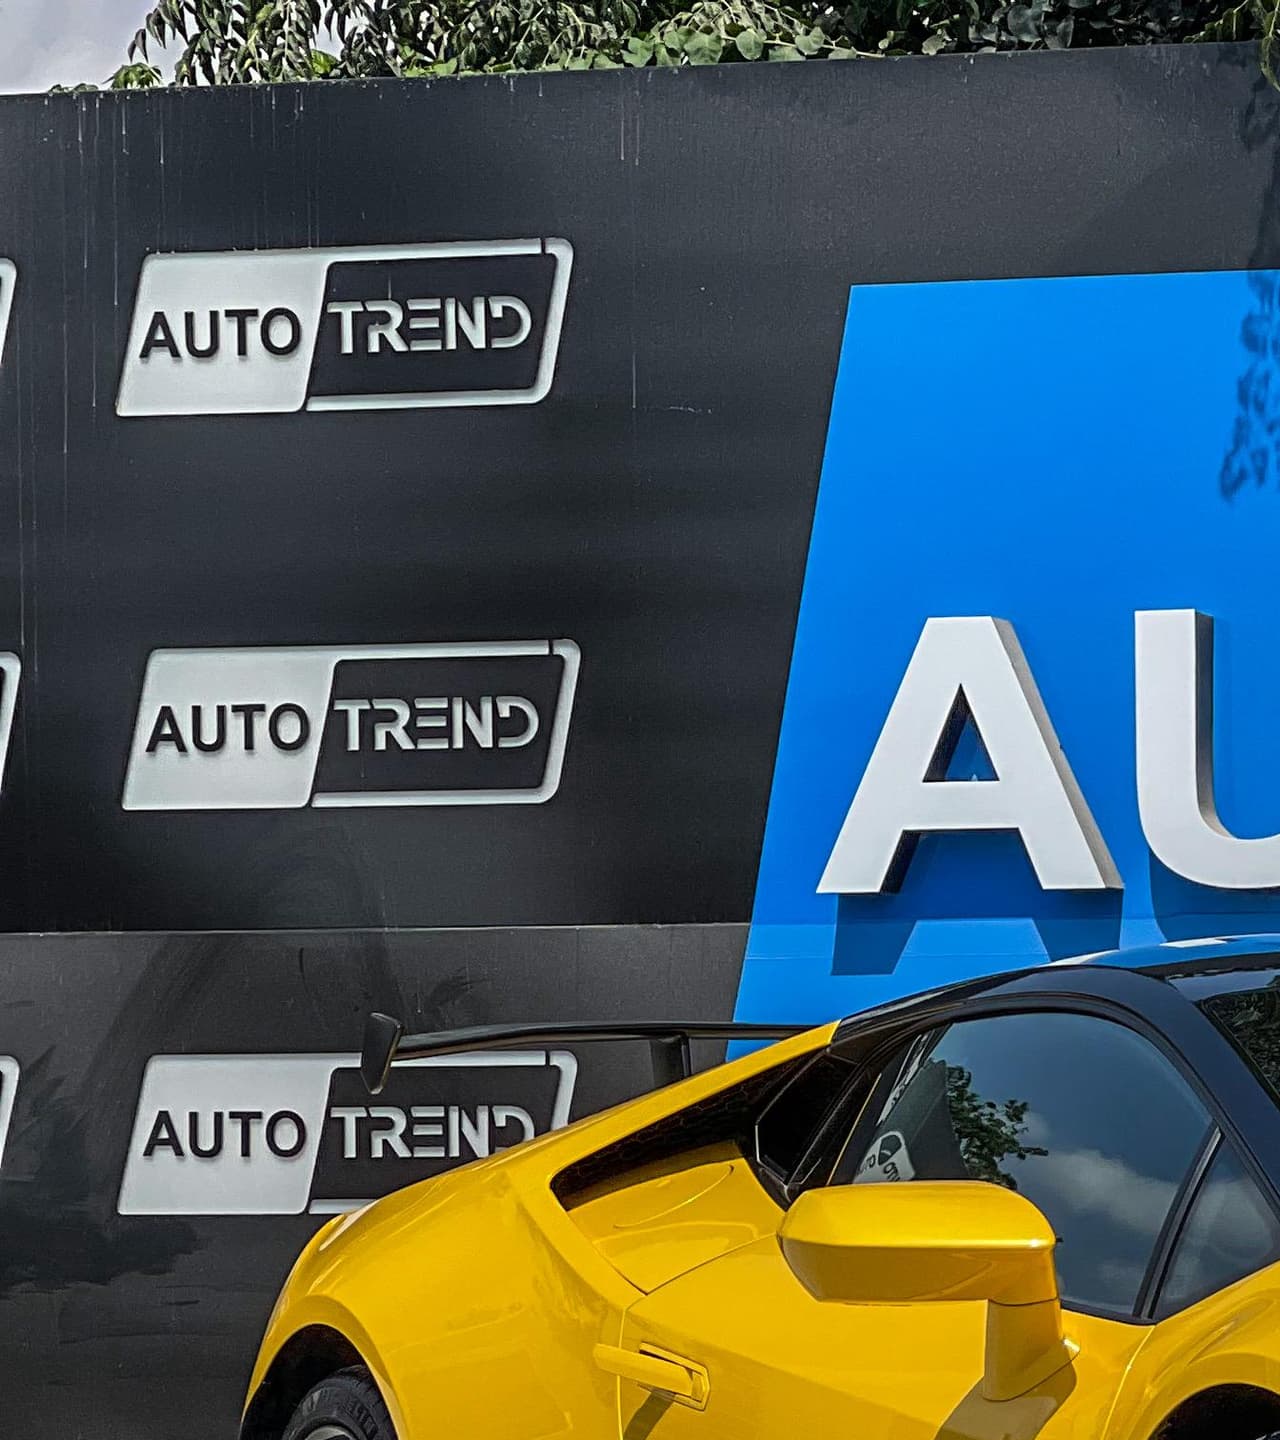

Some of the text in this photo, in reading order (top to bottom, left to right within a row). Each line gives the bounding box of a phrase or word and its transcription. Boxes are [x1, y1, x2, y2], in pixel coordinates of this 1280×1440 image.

[140, 296, 533, 358] AUTO TREND
[146, 696, 540, 752] AUTO TREND
[142, 1105, 535, 1158] AUTO TREND
